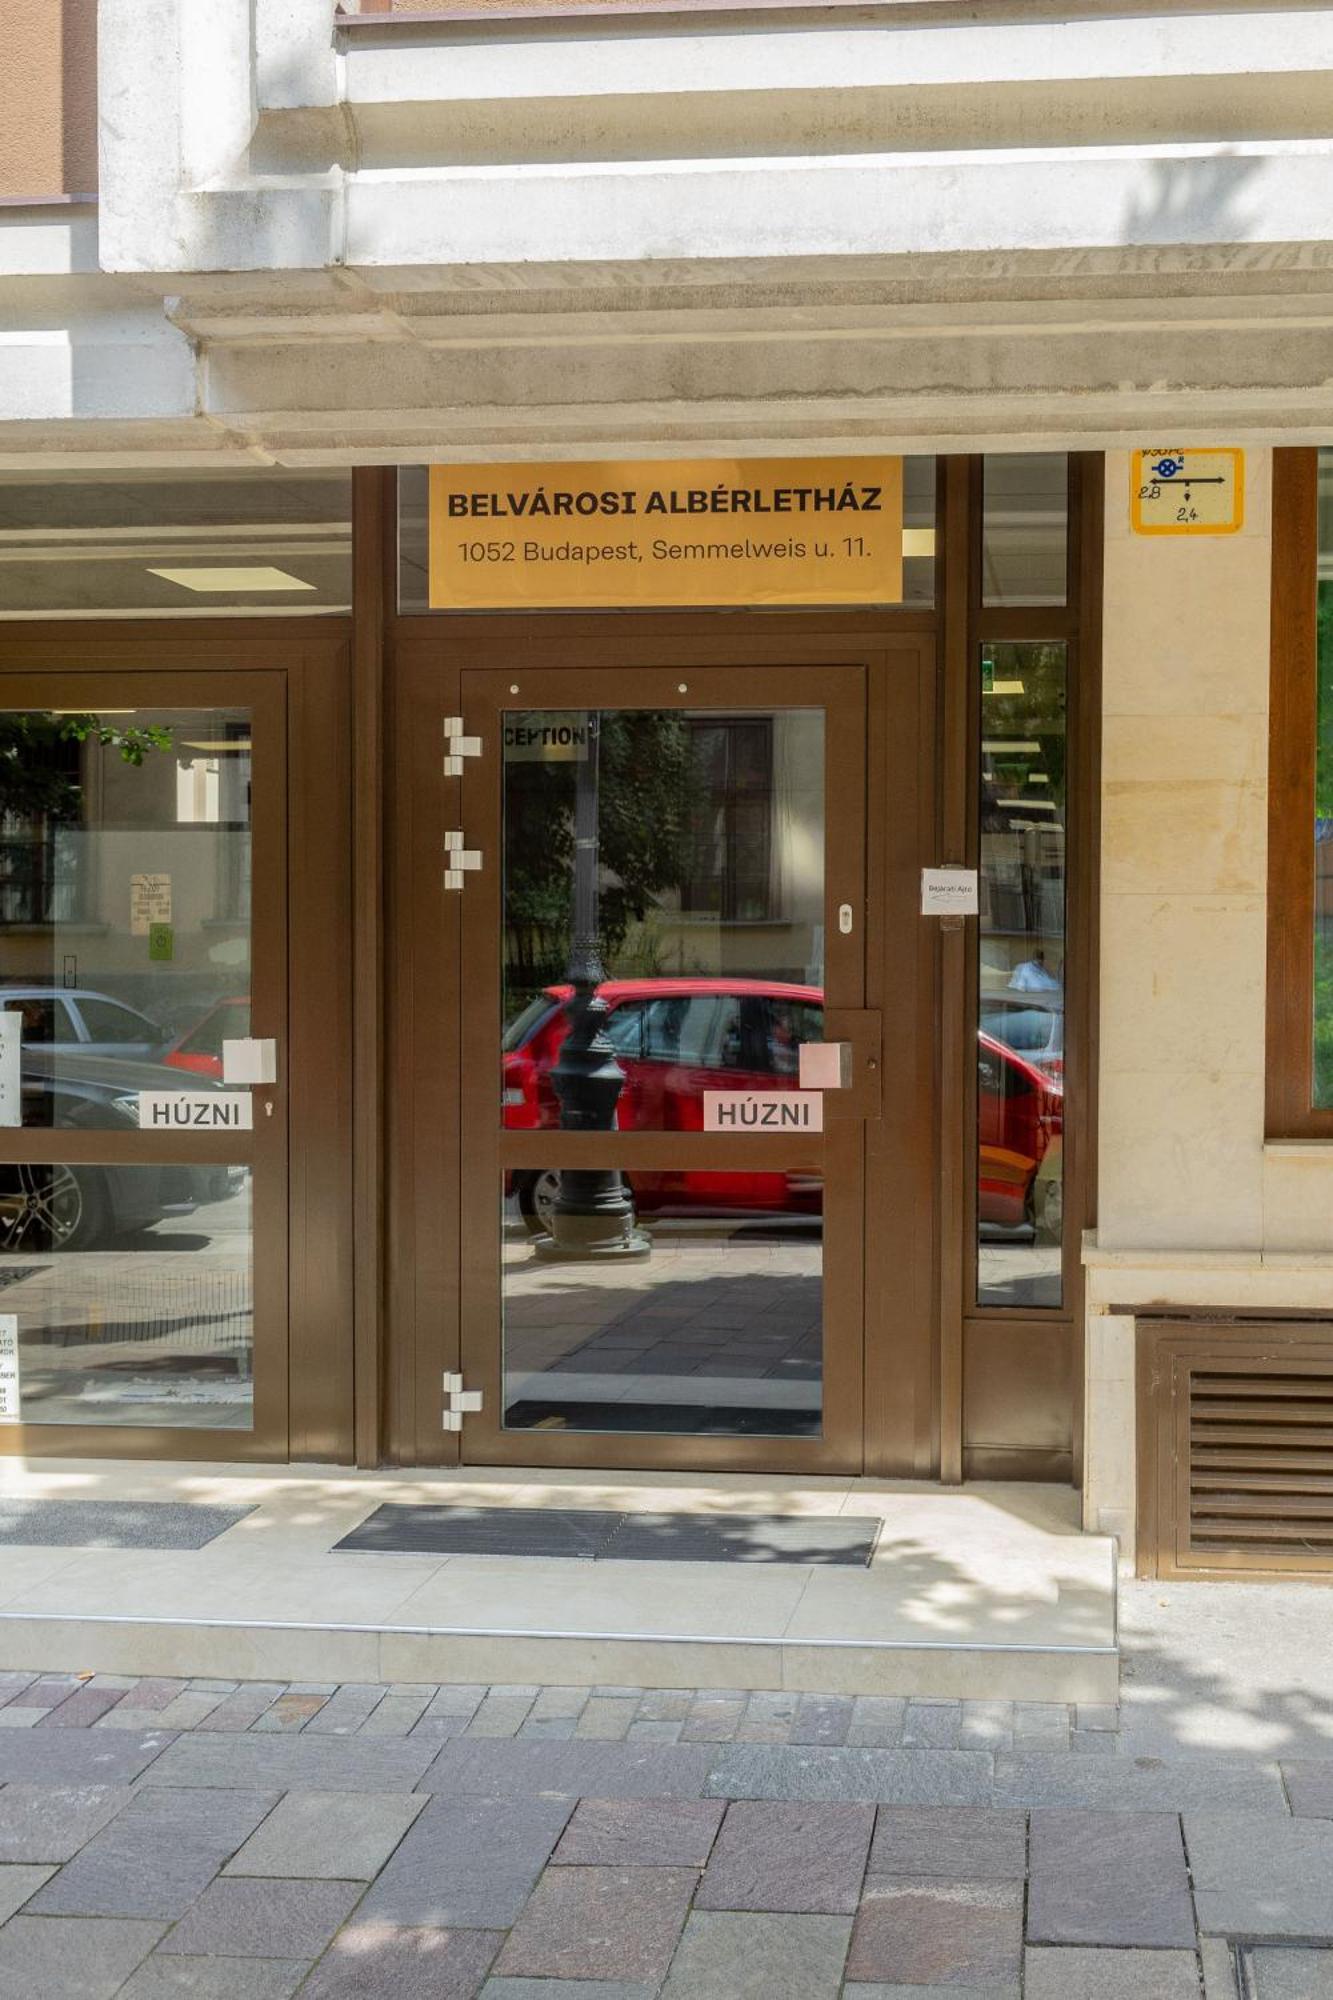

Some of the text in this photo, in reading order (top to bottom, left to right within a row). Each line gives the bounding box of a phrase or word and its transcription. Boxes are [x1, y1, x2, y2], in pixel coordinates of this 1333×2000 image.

[448, 481, 882, 517] BELVÁROSI ALBÉRLETHÁZ
[458, 536, 872, 566] 1052 Budapest, Semmelweis u. 11.
[152, 1096, 240, 1125] HÚZNI
[718, 1096, 809, 1126] HÚZNI
